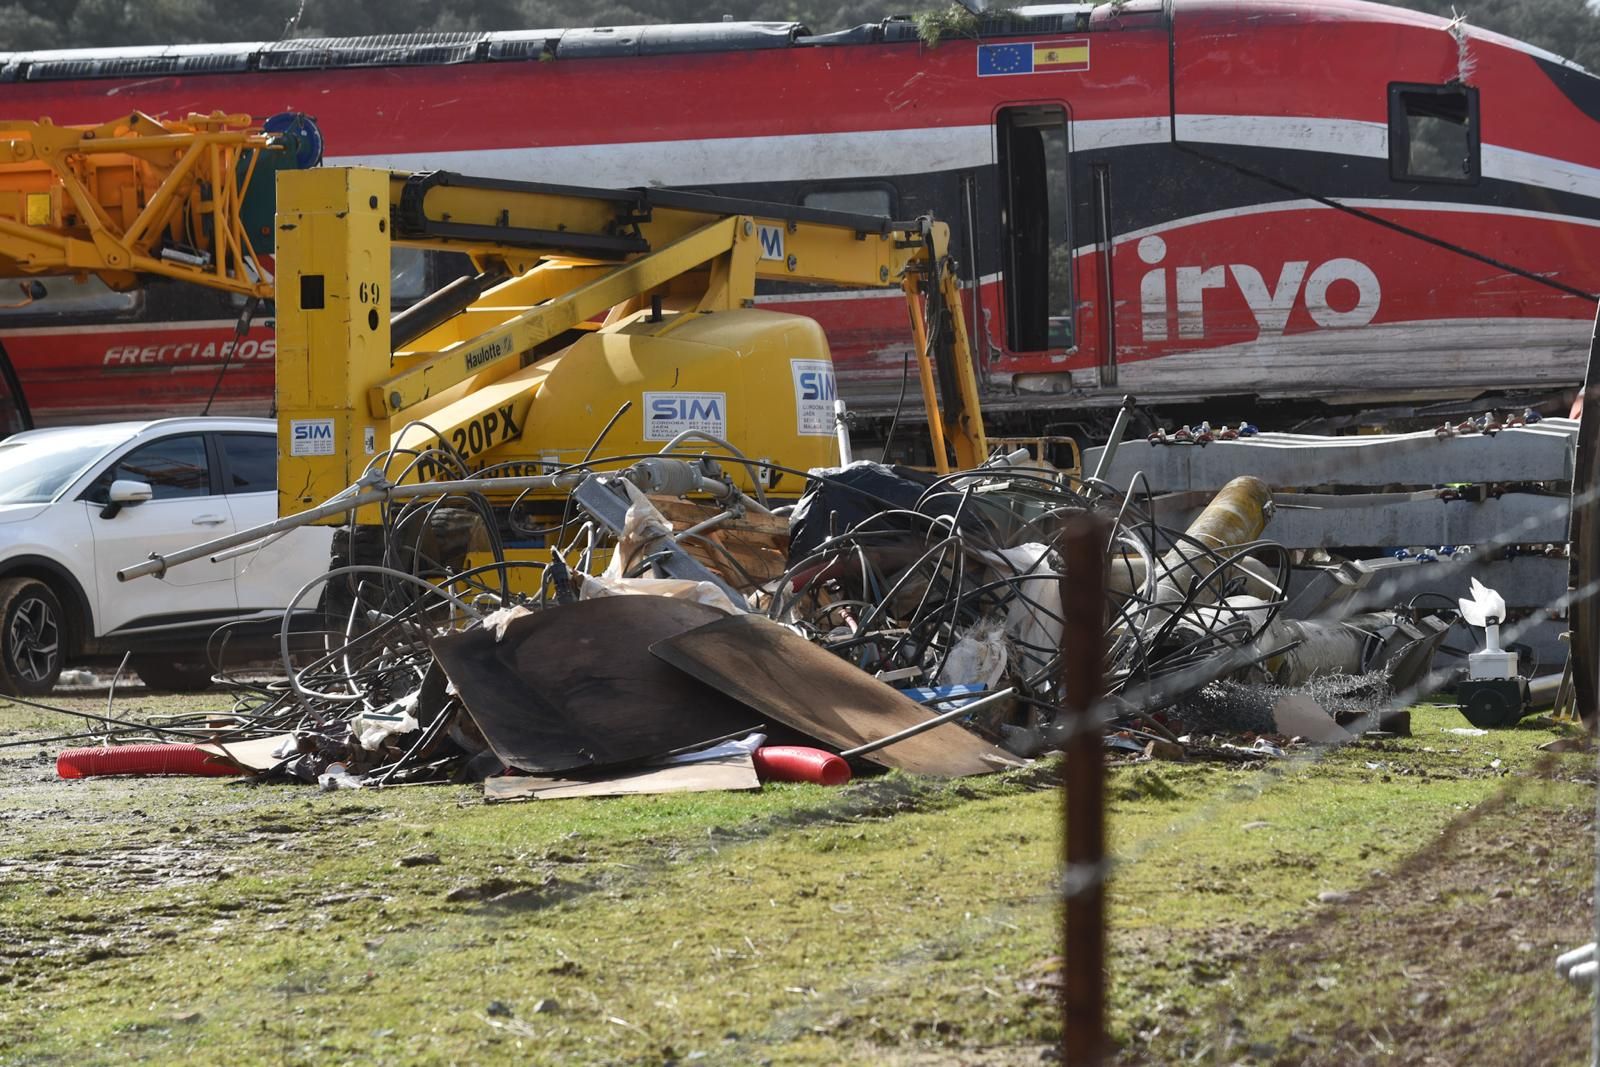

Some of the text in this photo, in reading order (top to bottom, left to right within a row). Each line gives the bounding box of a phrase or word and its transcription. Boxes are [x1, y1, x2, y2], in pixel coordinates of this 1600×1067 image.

[359, 281, 380, 305] 69
[1137, 235, 1381, 350] iryo
[465, 343, 501, 370] Haulotte
[652, 399, 721, 420] SIM
[295, 425, 331, 439] SIM
